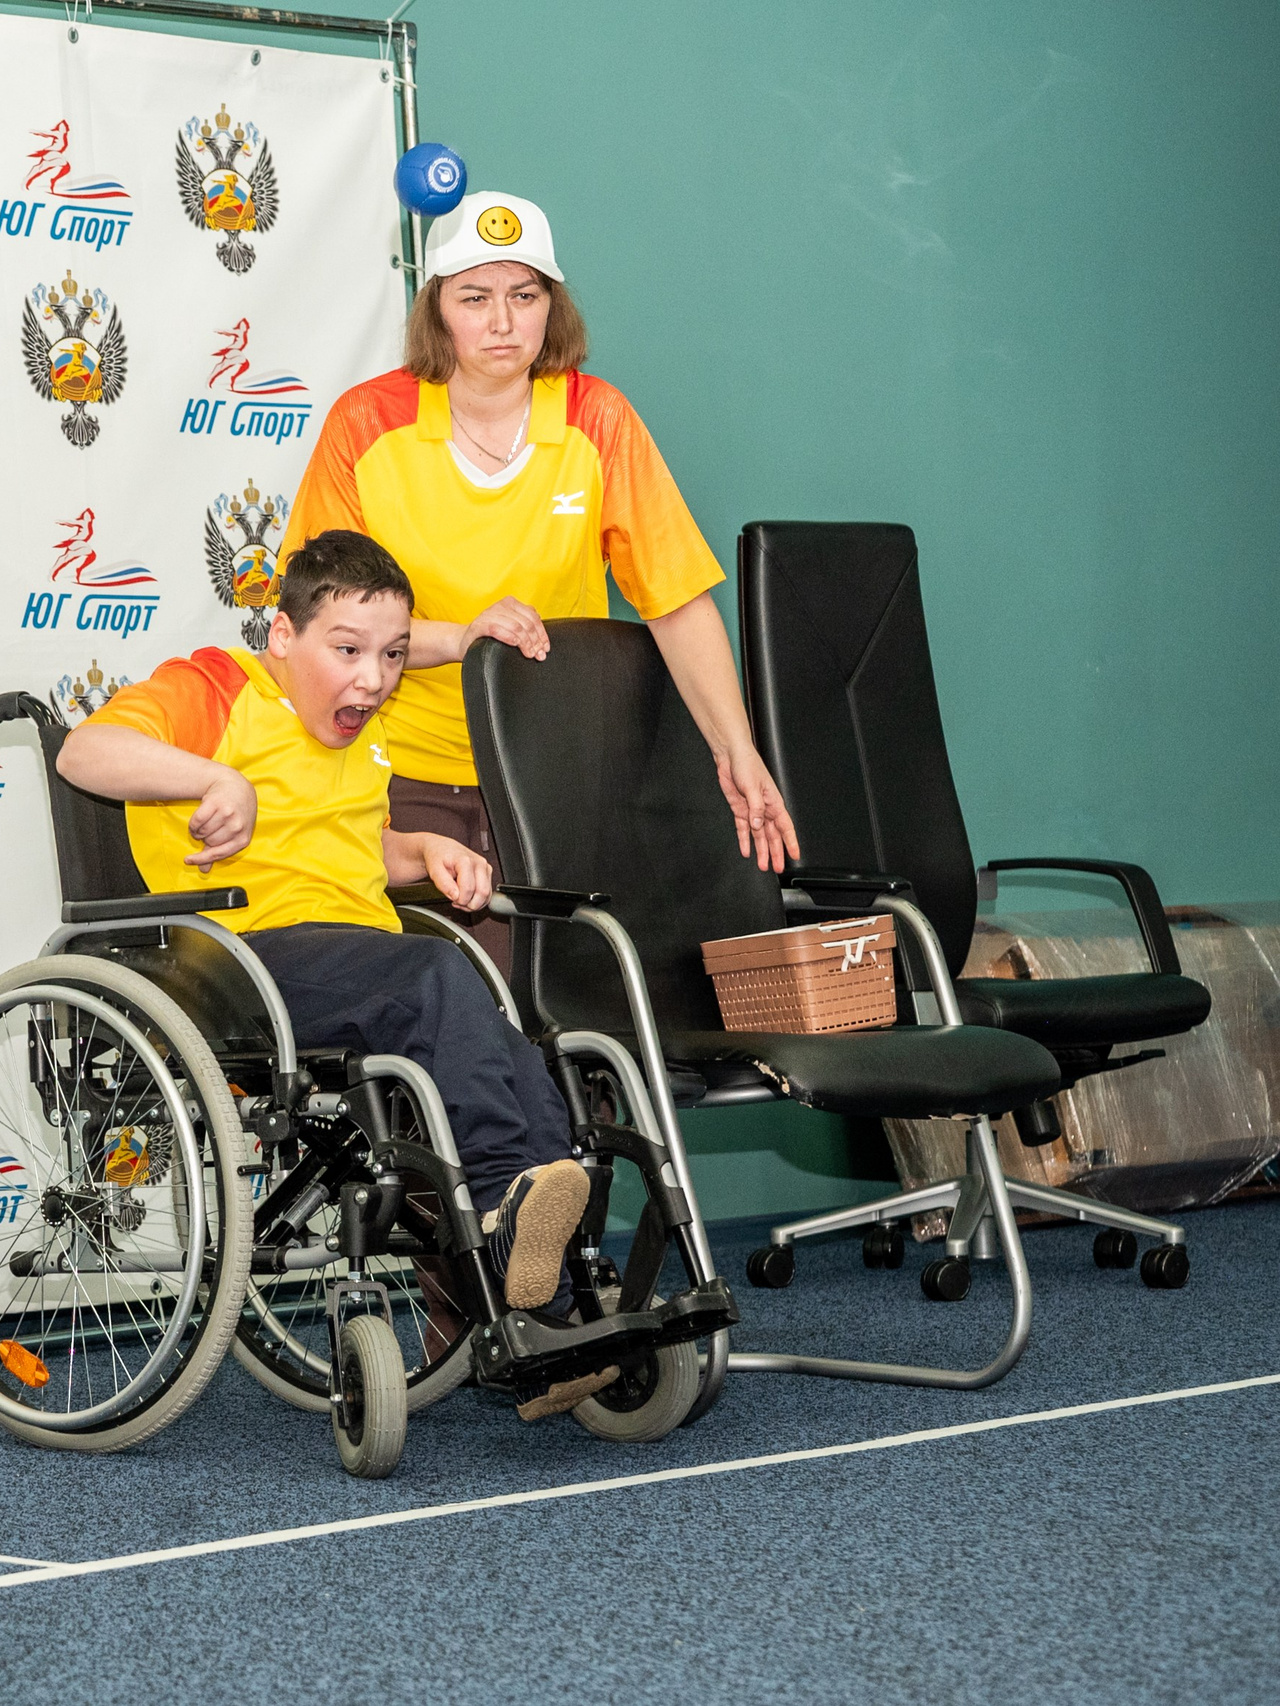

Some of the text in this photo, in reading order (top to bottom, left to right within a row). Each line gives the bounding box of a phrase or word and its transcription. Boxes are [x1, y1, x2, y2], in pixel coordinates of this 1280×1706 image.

[51, 206, 133, 252] Спорт
[181, 399, 313, 445] ЮГ Спорт
[22, 593, 161, 639] ЮГ Спорт
